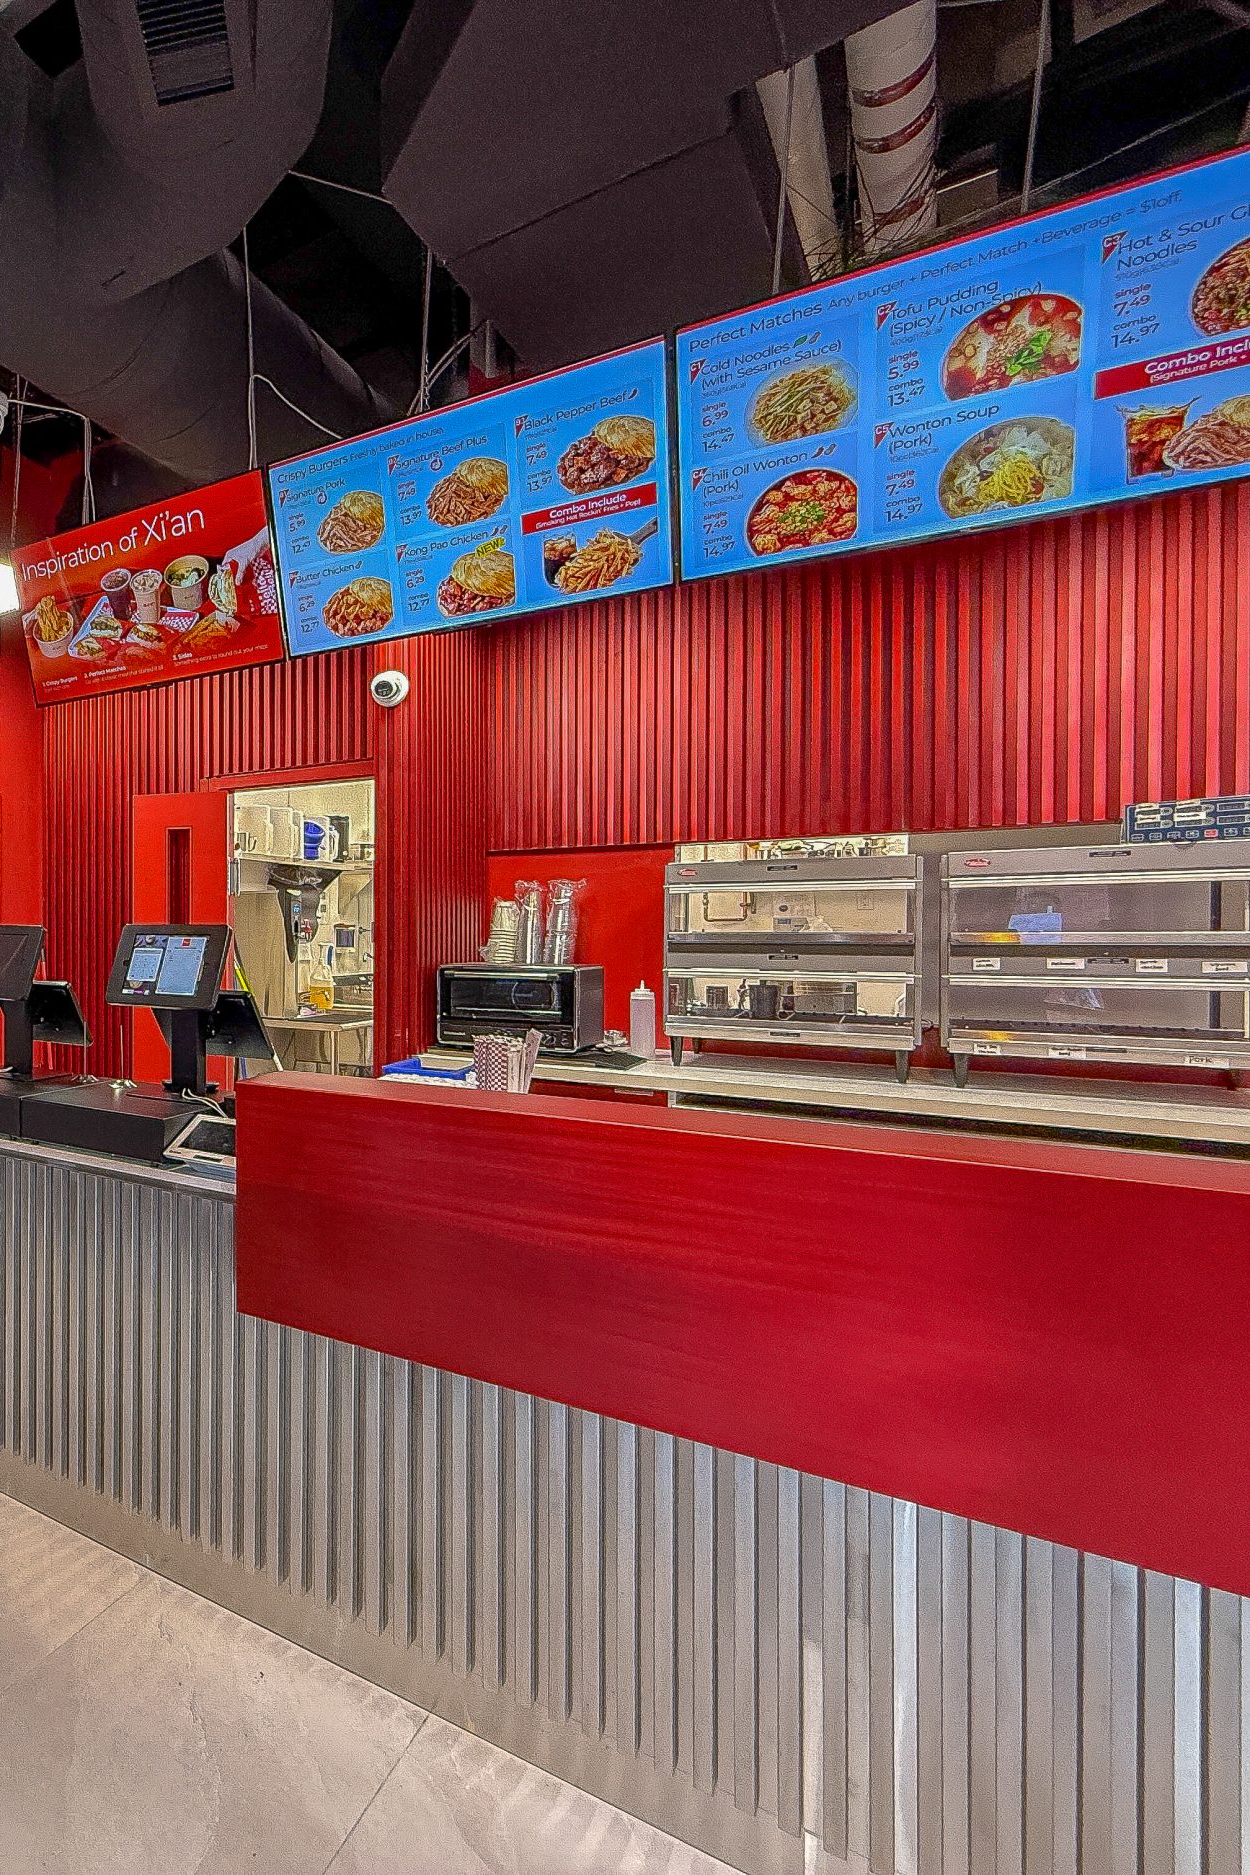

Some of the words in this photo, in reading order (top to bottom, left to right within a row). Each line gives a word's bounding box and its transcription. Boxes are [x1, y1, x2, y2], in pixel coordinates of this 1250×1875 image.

[1118, 234, 1153, 255] Hot
[1159, 229, 1172, 242] &
[1178, 214, 1226, 237] Sour
[1116, 239, 1198, 271] Noodles
[828, 293, 855, 310] Any
[857, 278, 904, 301] burger
[920, 258, 974, 281] Perfect
[978, 239, 1028, 263] Match
[890, 302, 923, 321] Tofu
[928, 280, 999, 308] Pudding
[1114, 282, 1151, 299] single
[890, 314, 937, 338] (Spicy
[938, 307, 947, 324] /
[950, 281, 1042, 318] Non-Spicy)
[1113, 294, 1151, 317] 7.49
[690, 326, 746, 352] Perfect
[750, 303, 822, 334] Matches
[1113, 314, 1157, 332] combo
[1111, 322, 1160, 349] 14.97
[701, 358, 730, 375] Cold
[734, 341, 791, 366] Noodles
[701, 370, 733, 389] (with
[737, 357, 791, 379] Sesame
[794, 339, 842, 362] Sauce)
[888, 350, 919, 363] single
[1144, 351, 1212, 374] Combo
[1215, 339, 1250, 358] Incl
[888, 361, 920, 381] 5.99
[1150, 363, 1207, 383] (Signature
[1209, 356, 1238, 368] Pork
[888, 378, 924, 392] combo
[887, 386, 925, 407] 13.47
[524, 414, 554, 430] Black
[556, 402, 597, 420] Pepper
[600, 391, 628, 408] Beef
[702, 401, 727, 413] single
[702, 410, 729, 427] 6.99
[889, 416, 952, 438] Wonton
[957, 405, 1000, 423] Soup
[702, 427, 732, 439] combo
[702, 433, 735, 453] 14.47
[395, 449, 440, 470] Signature
[441, 441, 465, 456] Beef
[466, 435, 488, 447] Plus
[889, 433, 932, 454] (Pork)
[277, 468, 307, 483] Crispy
[308, 455, 349, 475] Burgers
[380, 440, 406, 452] baked
[526, 450, 548, 466] 7.49
[702, 468, 729, 484] Chili
[732, 463, 750, 477] Oil
[753, 452, 808, 472] Wonton
[527, 469, 551, 480] combo
[527, 476, 553, 493] 13.97
[886, 470, 915, 481] single
[287, 484, 325, 502] Signature
[325, 478, 346, 491] Pork
[398, 487, 416, 501] 7.49
[703, 480, 739, 499] (Pork)
[885, 479, 915, 496] 7.49
[400, 505, 421, 514] combo
[549, 505, 586, 519] Combo
[588, 493, 627, 510] Include
[886, 496, 921, 508] combo
[401, 510, 422, 526] 13.97
[566, 513, 578, 521] Hot
[703, 511, 728, 521] single
[885, 503, 923, 523] 14.97
[703, 519, 728, 535] 7.49
[21, 540, 114, 581] Inspiration
[119, 527, 138, 552] of
[141, 509, 205, 546] Xi'an
[404, 546, 428, 558] Kong
[430, 541, 449, 552] Pao
[450, 530, 489, 546] Chicken
[703, 541, 735, 558] 14.97
[704, 535, 733, 545] combo
[297, 571, 320, 583] Butter
[322, 563, 356, 577] Chicken
[406, 575, 425, 588] 6.29
[408, 598, 430, 612] 12.77
